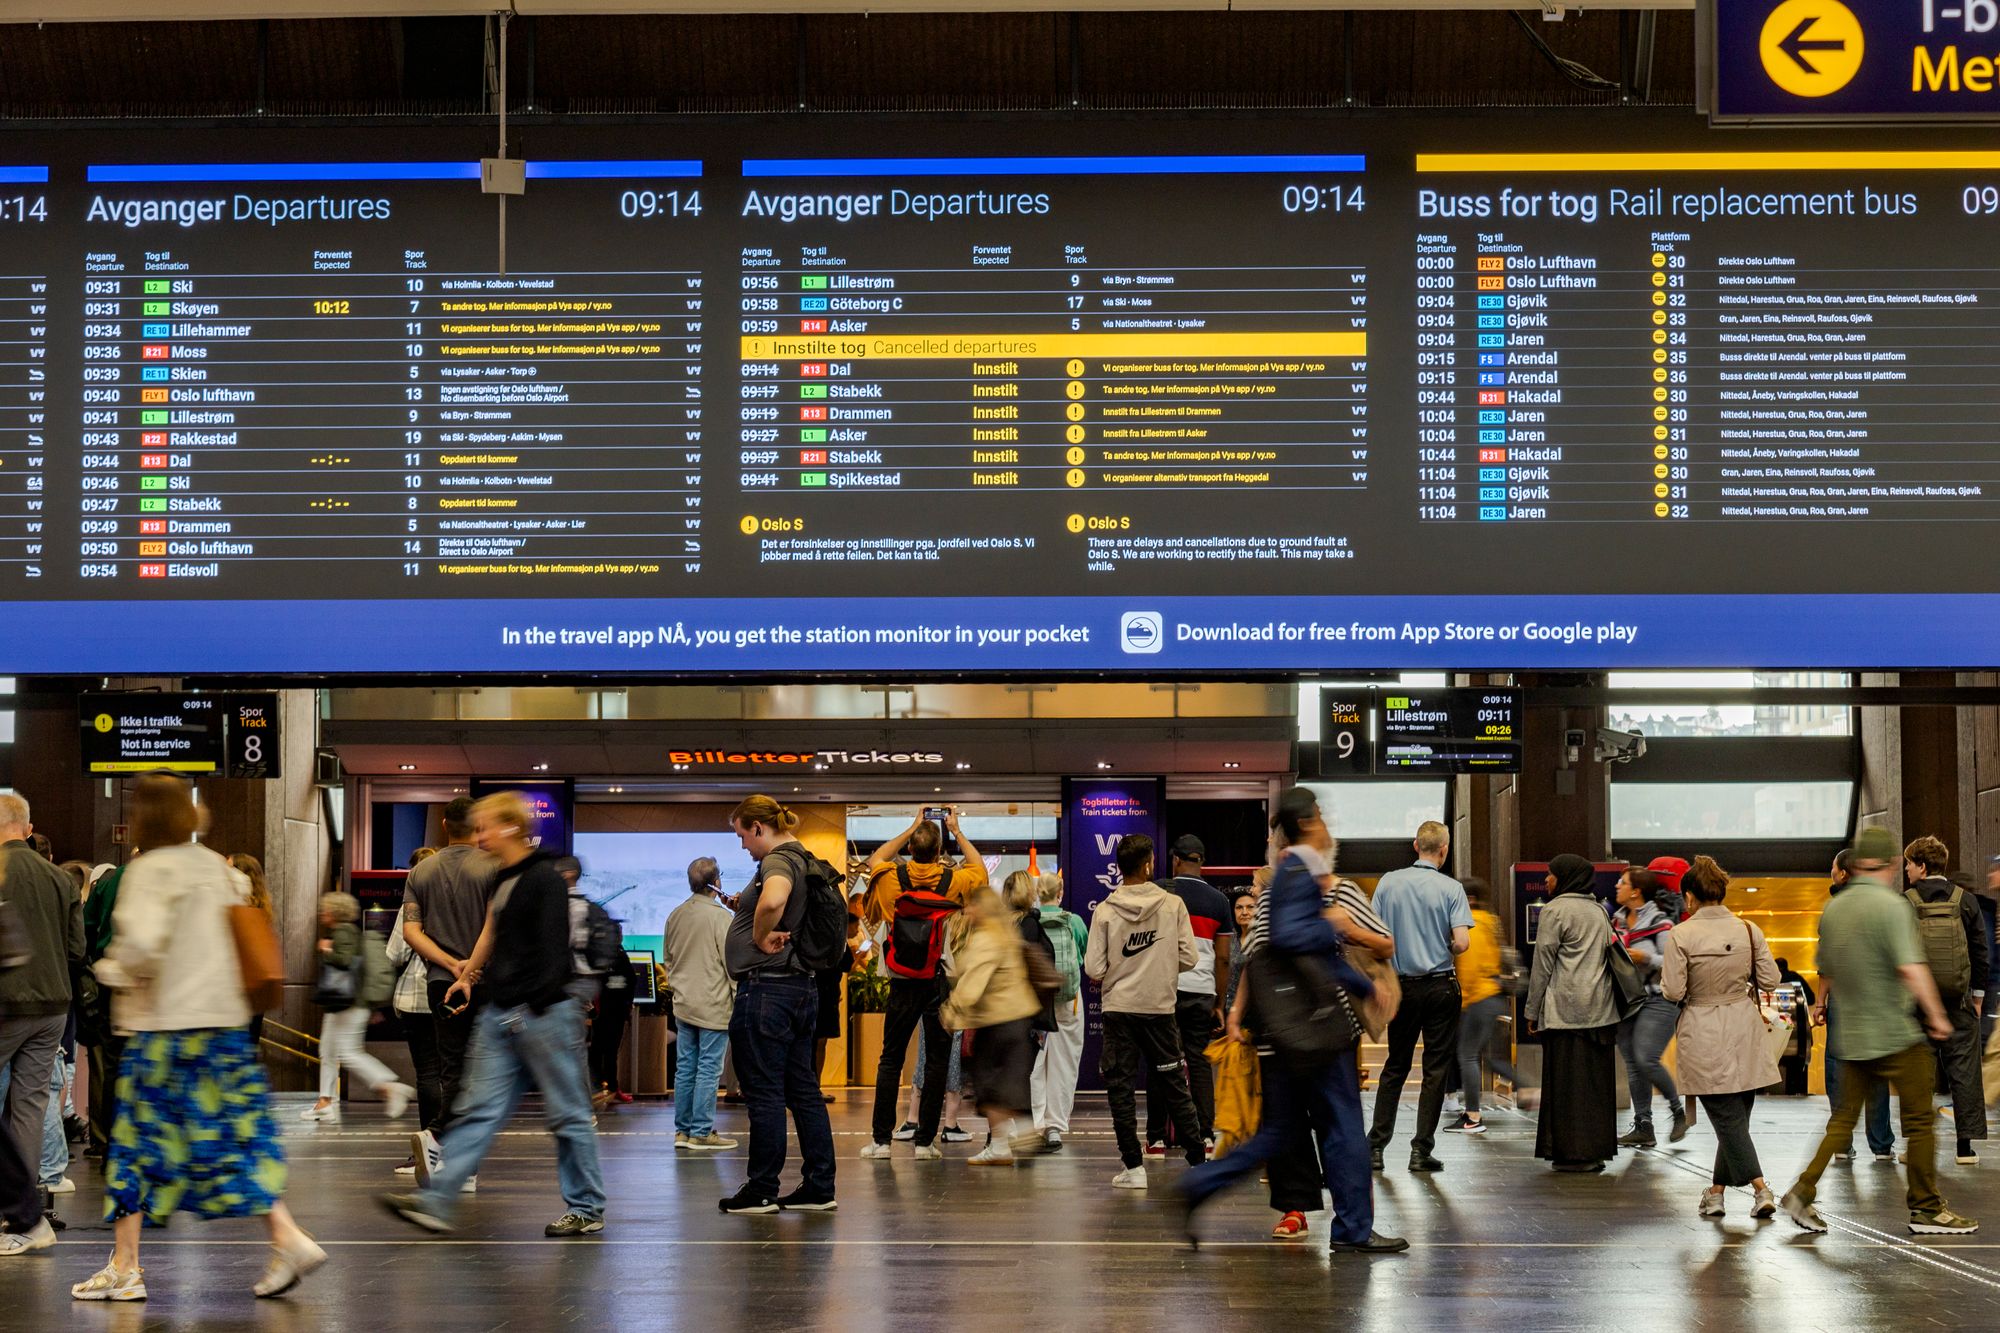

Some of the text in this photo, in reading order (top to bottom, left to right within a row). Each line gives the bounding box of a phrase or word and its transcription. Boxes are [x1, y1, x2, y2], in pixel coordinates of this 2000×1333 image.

[622, 191, 702, 217] 09:14
[1284, 186, 1365, 212] 09:14
[1420, 188, 1597, 222] Buss for tog
[1611, 187, 1916, 221] Rail replacement bus
[1964, 187, 1998, 214] 09
[0, 196, 48, 222] :14
[87, 196, 225, 227] Avganger
[234, 195, 389, 226] Departures
[742, 191, 882, 222] Avganger
[892, 190, 1049, 221] Departures
[1652, 232, 1690, 240] Plattform
[1652, 243, 1673, 251] Track
[86, 253, 116, 264] Avgang
[145, 252, 160, 261] Tog
[405, 251, 424, 259] Spor
[86, 263, 124, 272] Departure
[315, 261, 350, 270] Expected
[1507, 256, 1596, 268] Oslo Lufthavn
[86, 282, 120, 293] 09:31
[173, 280, 192, 293] Ski
[407, 279, 423, 291] 10
[742, 277, 778, 288] 09:56
[831, 276, 894, 288] Lillestrøm
[314, 301, 349, 313] 10:12
[473, 303, 487, 311] tog.
[504, 302, 547, 311] informasjon
[548, 302, 557, 311] på
[558, 302, 572, 311] Vys
[573, 303, 587, 311] app
[742, 299, 778, 310] 09:58
[830, 298, 902, 312] Göteborg C
[1418, 296, 1454, 307] 09:04
[85, 303, 119, 315] 09:31
[172, 302, 218, 317] Skøyen
[1507, 313, 1547, 329] Gjøvik
[1720, 314, 1872, 323] Gran, Jaren, Eina, Reinsvoll, Raufoss, Gjøvik
[85, 325, 121, 337] 09:34
[172, 323, 251, 336] Lillehammer
[407, 323, 421, 335] 11
[742, 321, 777, 332] 09:59
[830, 319, 867, 332] Asker
[1507, 333, 1544, 345] Jaren
[85, 346, 120, 358] 09:36
[172, 346, 207, 358] Moss
[774, 340, 1036, 356] Innstilte tog Cancelled departures
[84, 368, 120, 380] 09:39
[171, 367, 206, 380] Skien
[974, 362, 1018, 374] Innstilt
[1508, 371, 1557, 383] Arendal
[84, 390, 120, 402] 09:40
[171, 388, 254, 401] Oslo lufthavn
[406, 388, 422, 400] 13
[1508, 390, 1560, 403] Hakadal
[171, 410, 234, 424] Lillestrøm
[170, 432, 236, 445] Rakkestad
[830, 473, 900, 488] Spikkestad
[169, 497, 221, 511] Stabekk
[1420, 506, 1456, 518] 11:04
[169, 520, 231, 532] Drammen
[762, 518, 803, 530] Oslo S
[1088, 516, 1129, 529] Oslo S
[1088, 538, 1115, 547] There
[1134, 537, 1163, 548] delays
[1166, 537, 1183, 546] and
[1185, 537, 1246, 546] cancellations
[1248, 537, 1265, 546] due
[1267, 538, 1277, 546] to
[1280, 537, 1311, 548] ground
[1314, 537, 1335, 546] fault
[1337, 537, 1347, 546] at
[168, 563, 218, 576] Eidsvoll
[503, 622, 1089, 648] In the travel app NÅ, you get the station monitor in your pocket
[1177, 622, 1637, 644] Download for free from App Store or Google play
[240, 707, 263, 718] Spor
[1333, 702, 1356, 713] Spor
[121, 716, 182, 726] Ikke i trafikk
[1333, 712, 1359, 722] Track
[1387, 710, 1447, 721] Lillestrøm
[1478, 710, 1510, 721] 09:11
[240, 717, 266, 727] Track
[1486, 726, 1511, 734] 09:26
[122, 739, 190, 748] Not in service
[245, 736, 261, 762] 8
[1337, 732, 1354, 758] 9
[669, 751, 943, 764] Billetter Tickets
[537, 800, 548, 808] fra
[1082, 798, 1140, 807] Togbilletter fra
[536, 810, 555, 818] from
[1082, 808, 1147, 816] Train tickets from
[1128, 930, 1157, 946] NIKE
